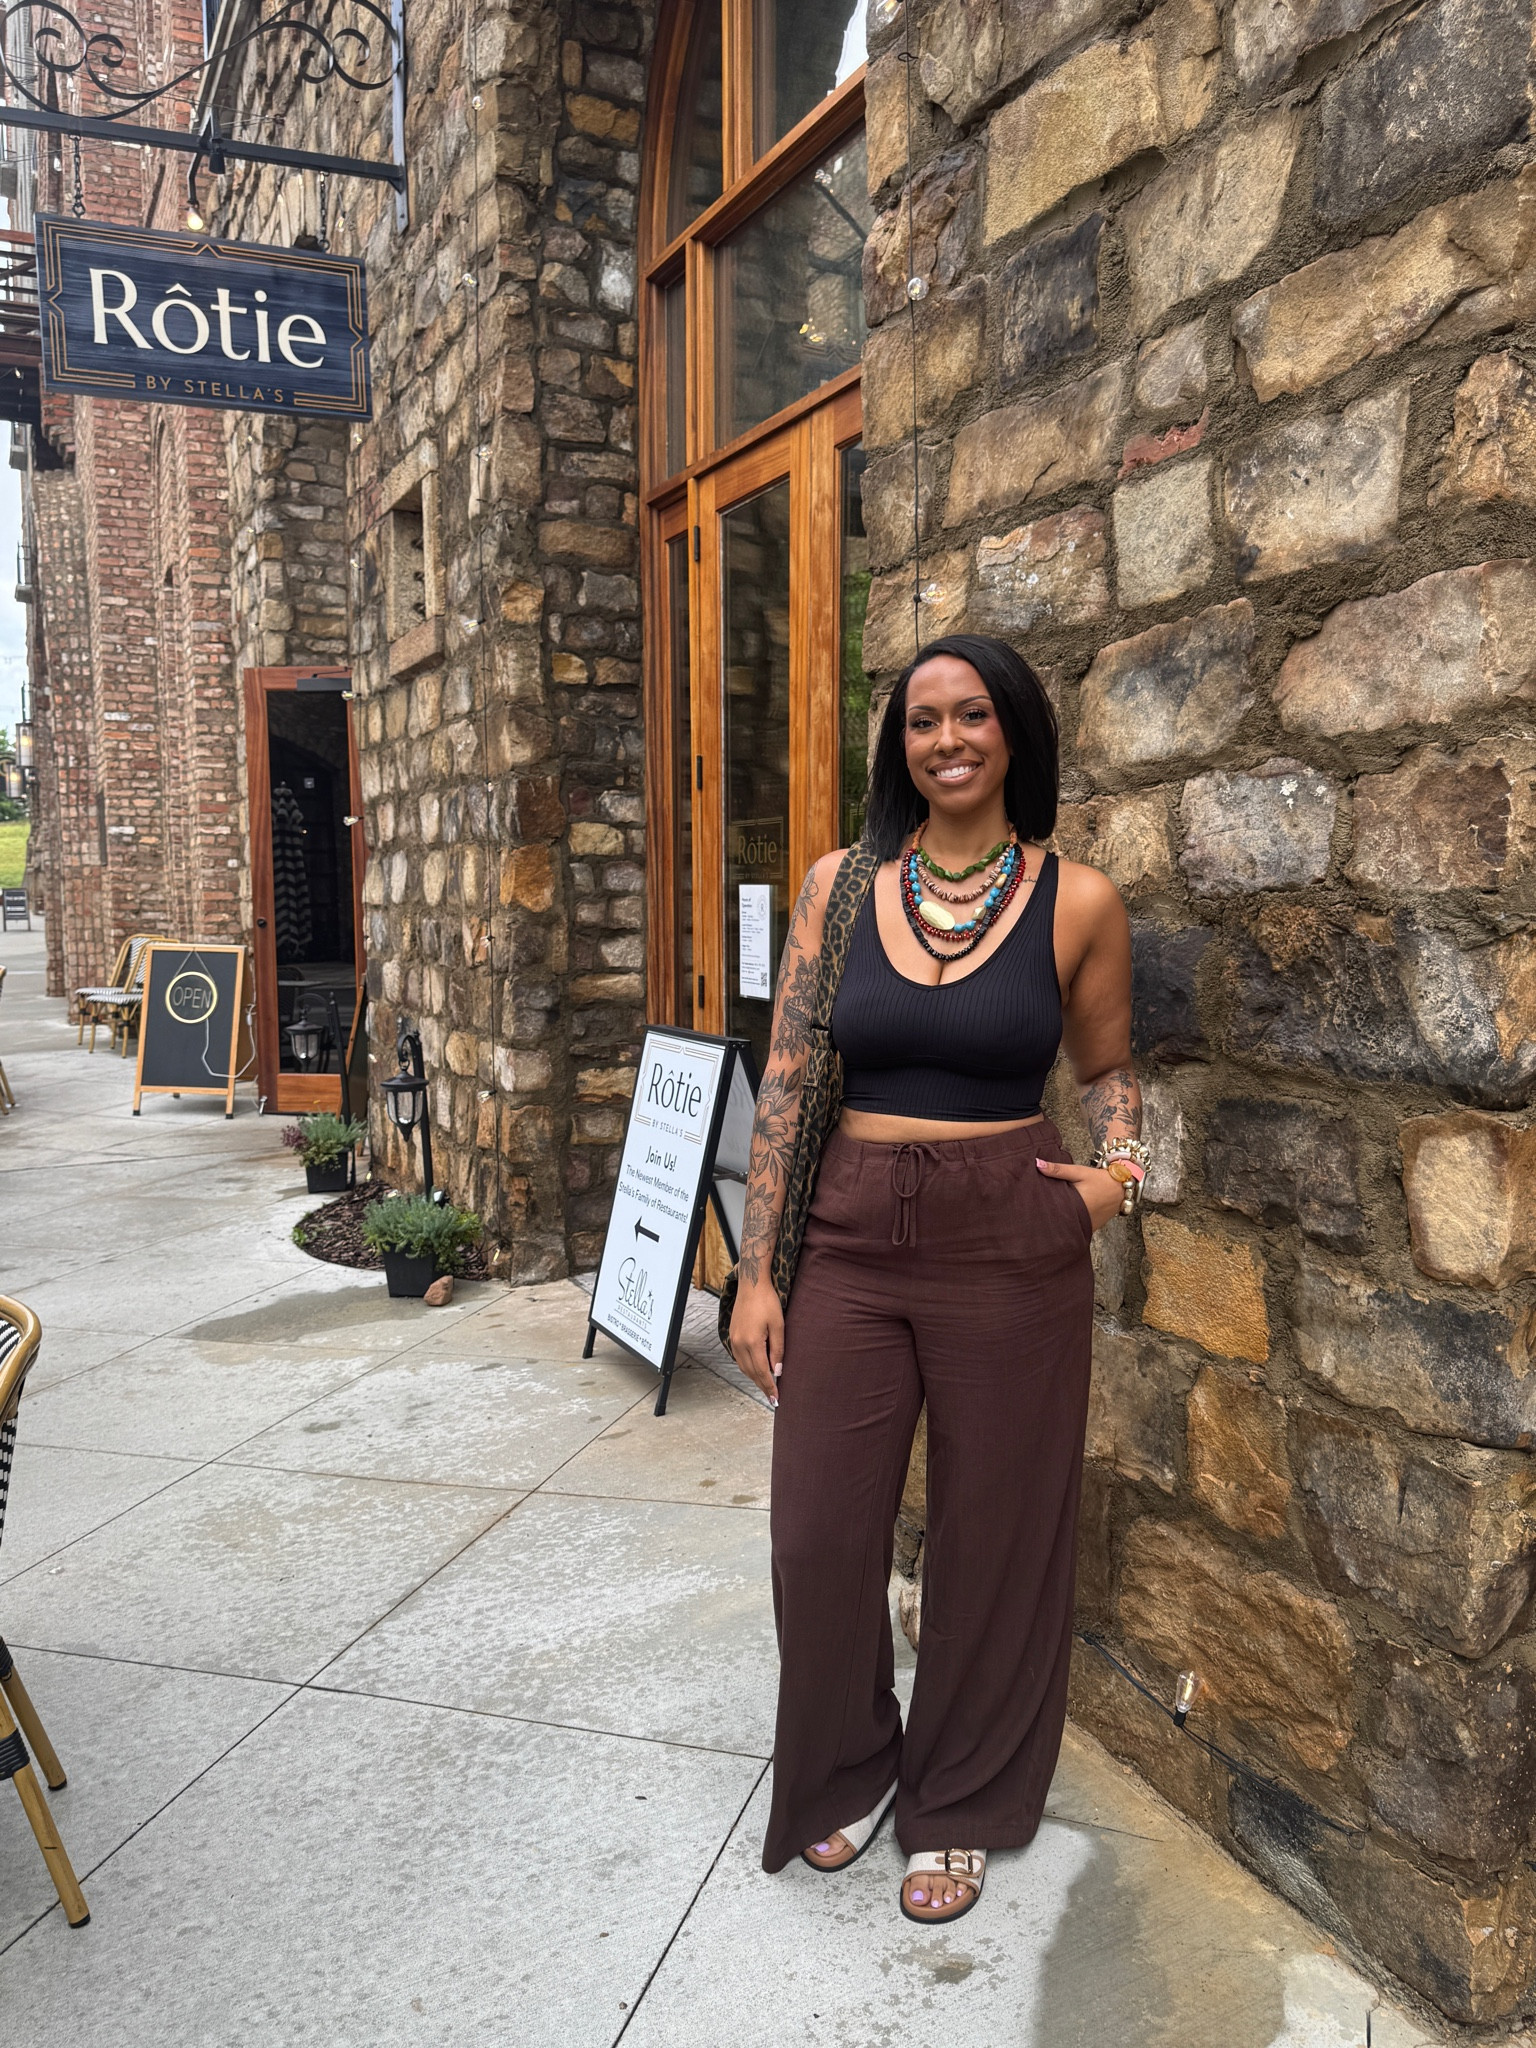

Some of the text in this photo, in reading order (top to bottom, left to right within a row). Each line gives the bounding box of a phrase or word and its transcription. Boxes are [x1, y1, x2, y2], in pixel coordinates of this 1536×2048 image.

[89, 268, 327, 369] Rôtie
[146, 375, 284, 402] BY STELLA'S
[738, 833, 778, 865] Rôtie
[172, 986, 212, 1009] OPEN
[648, 1063, 702, 1118] Rôtie
[651, 1119, 659, 1128] BY
[645, 1145, 678, 1172] Join Us!
[626, 1164, 689, 1202] The Newest Member of the
[618, 1181, 689, 1224] Stella's Family of Restaurants!
[617, 1257, 655, 1320] Stella's
